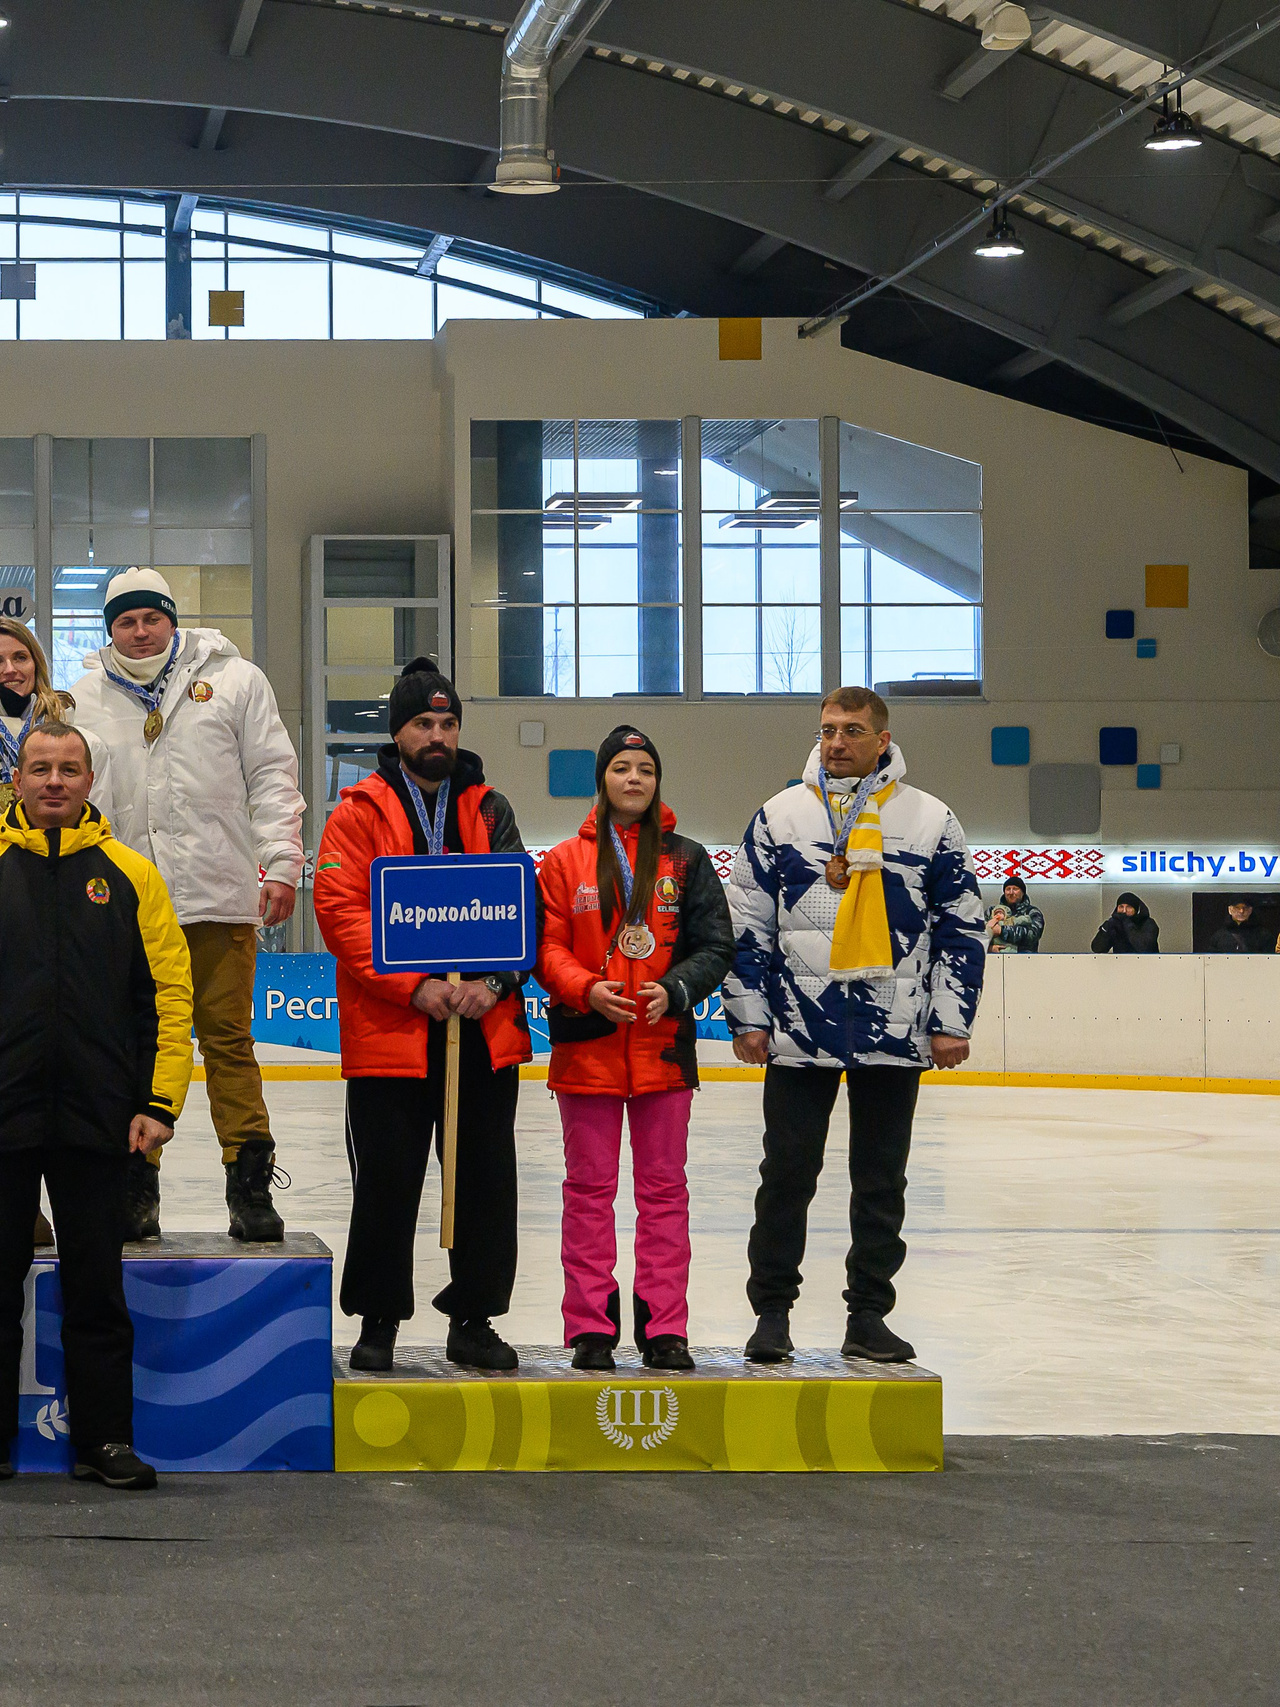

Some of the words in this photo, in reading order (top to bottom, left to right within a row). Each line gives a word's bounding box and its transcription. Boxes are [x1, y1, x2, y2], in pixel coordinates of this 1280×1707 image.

[1122, 850, 1279, 878] silichy.by
[389, 898, 518, 930] Агрохолдинг
[610, 1389, 665, 1426] III
